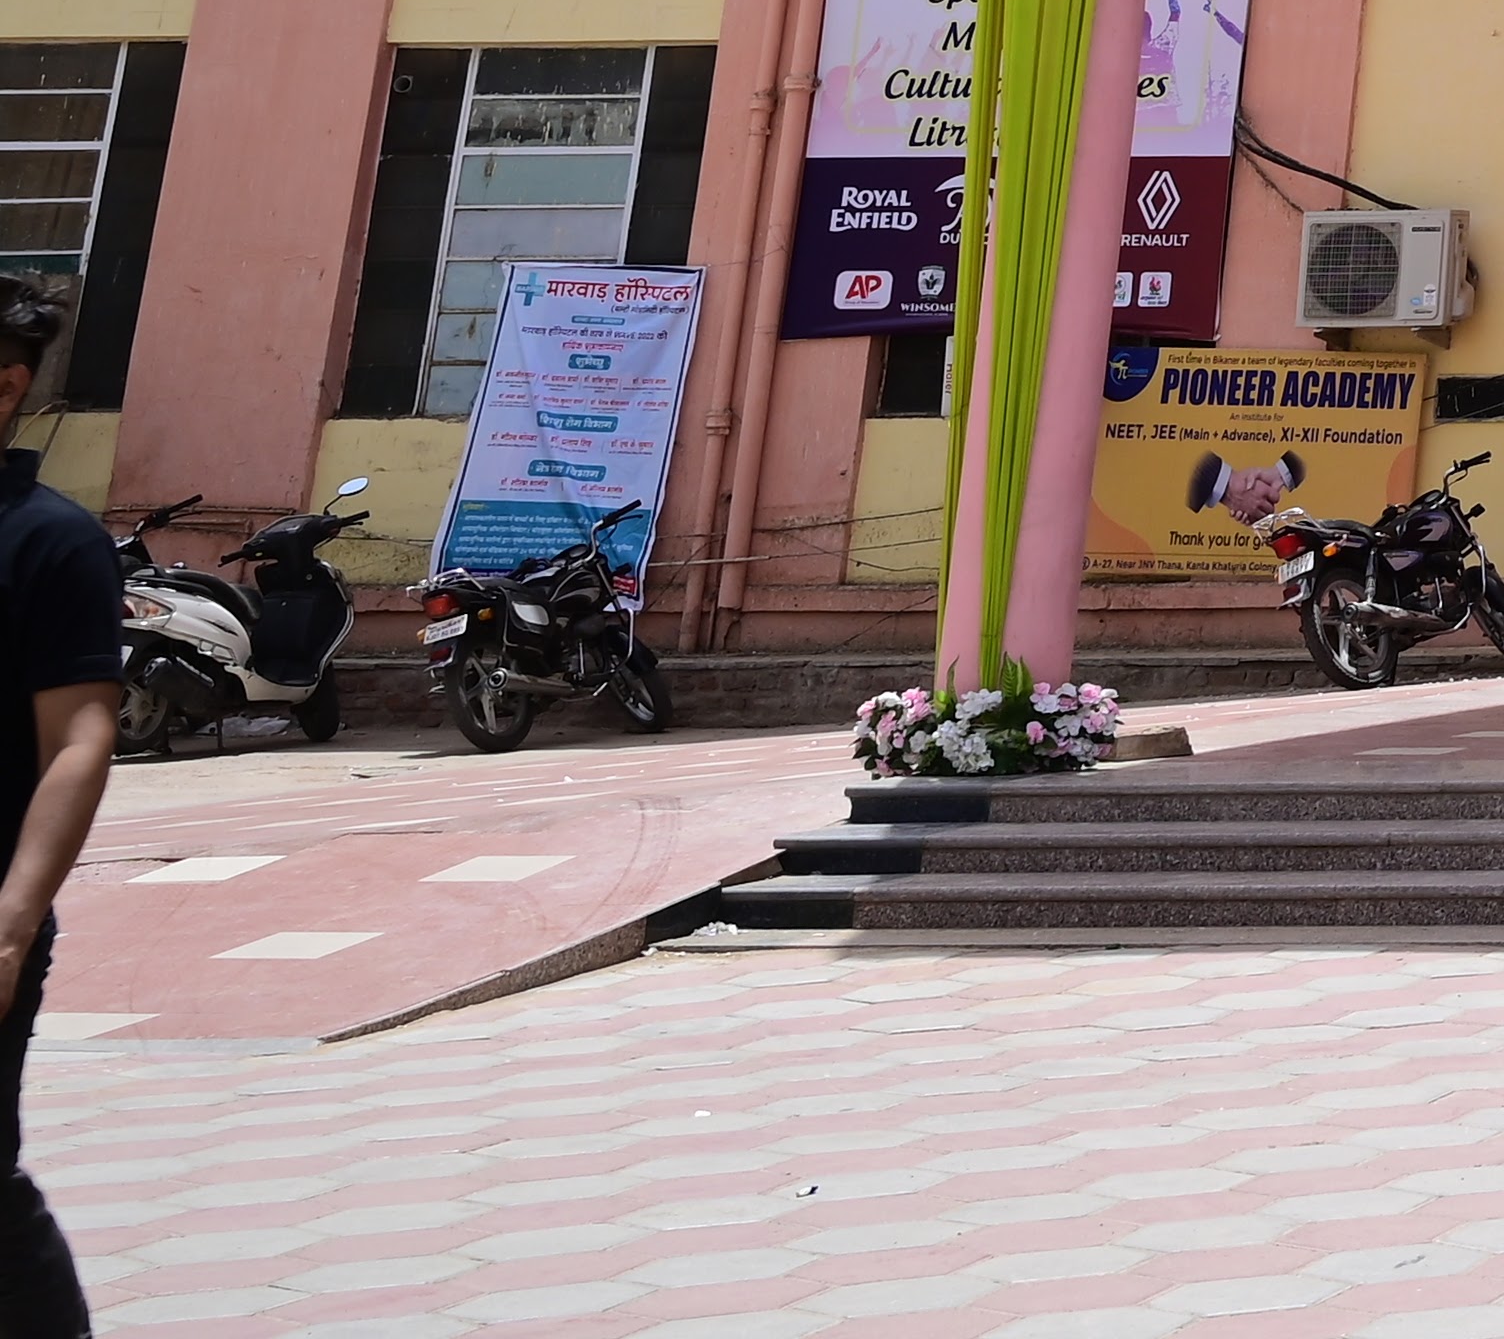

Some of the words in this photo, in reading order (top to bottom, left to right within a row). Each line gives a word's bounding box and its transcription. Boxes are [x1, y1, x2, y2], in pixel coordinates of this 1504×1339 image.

[842, 186, 911, 208] ROYAL
[829, 209, 917, 232] ENFIELD
[1121, 234, 1189, 247] RENAULT
[845, 274, 883, 300] AP
[901, 302, 955, 313] WINSOME
[1168, 354, 1185, 364] First
[1212, 355, 1240, 365] Bikaner
[1247, 357, 1266, 365] team
[1277, 356, 1314, 369] legendary
[1347, 359, 1375, 370] coming
[1161, 367, 1276, 406] PIONEER
[1280, 371, 1416, 410] ACADEMY
[1105, 424, 1147, 441] NEET,
[1151, 424, 1177, 440] JEE
[1179, 427, 1210, 442] (Main
[1221, 429, 1276, 443] Advance),
[1280, 426, 1319, 443] XI-XII
[1323, 428, 1403, 445] Foundation
[1169, 530, 1205, 547] Thank
[1208, 534, 1231, 551] you
[1233, 532, 1250, 547] for
[1116, 560, 1136, 569] Near
[1157, 560, 1184, 571] Thana,
